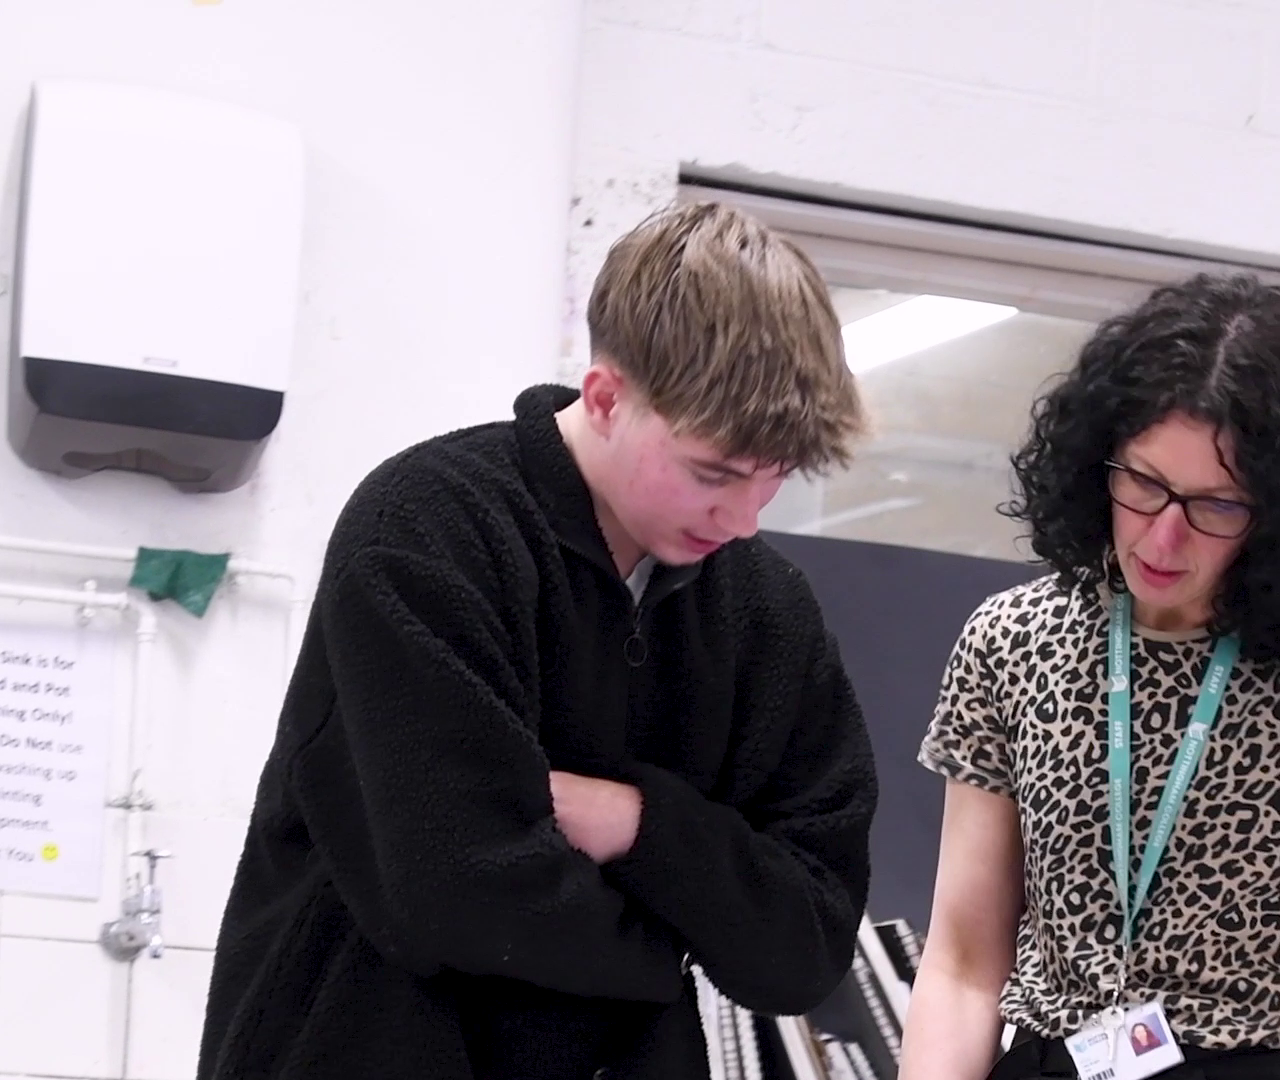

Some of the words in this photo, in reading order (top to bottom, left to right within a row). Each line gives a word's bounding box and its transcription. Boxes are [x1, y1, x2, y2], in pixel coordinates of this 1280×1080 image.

[0, 650, 32, 667] Sink
[36, 654, 49, 668] is
[52, 655, 76, 670] for
[10, 681, 40, 694] and
[44, 682, 70, 697] Pot
[1208, 665, 1225, 695] STAFF
[30, 708, 73, 727] Only!
[0, 734, 21, 748] Do
[25, 736, 53, 751] Not
[57, 743, 83, 754] use
[1114, 720, 1124, 749] STAFF
[57, 770, 77, 783] up
[1169, 740, 1198, 807] NOTTINGHAM
[1114, 778, 1124, 821] COLLEGE
[1153, 805, 1173, 848] COLLEGE
[6, 847, 35, 862] You
